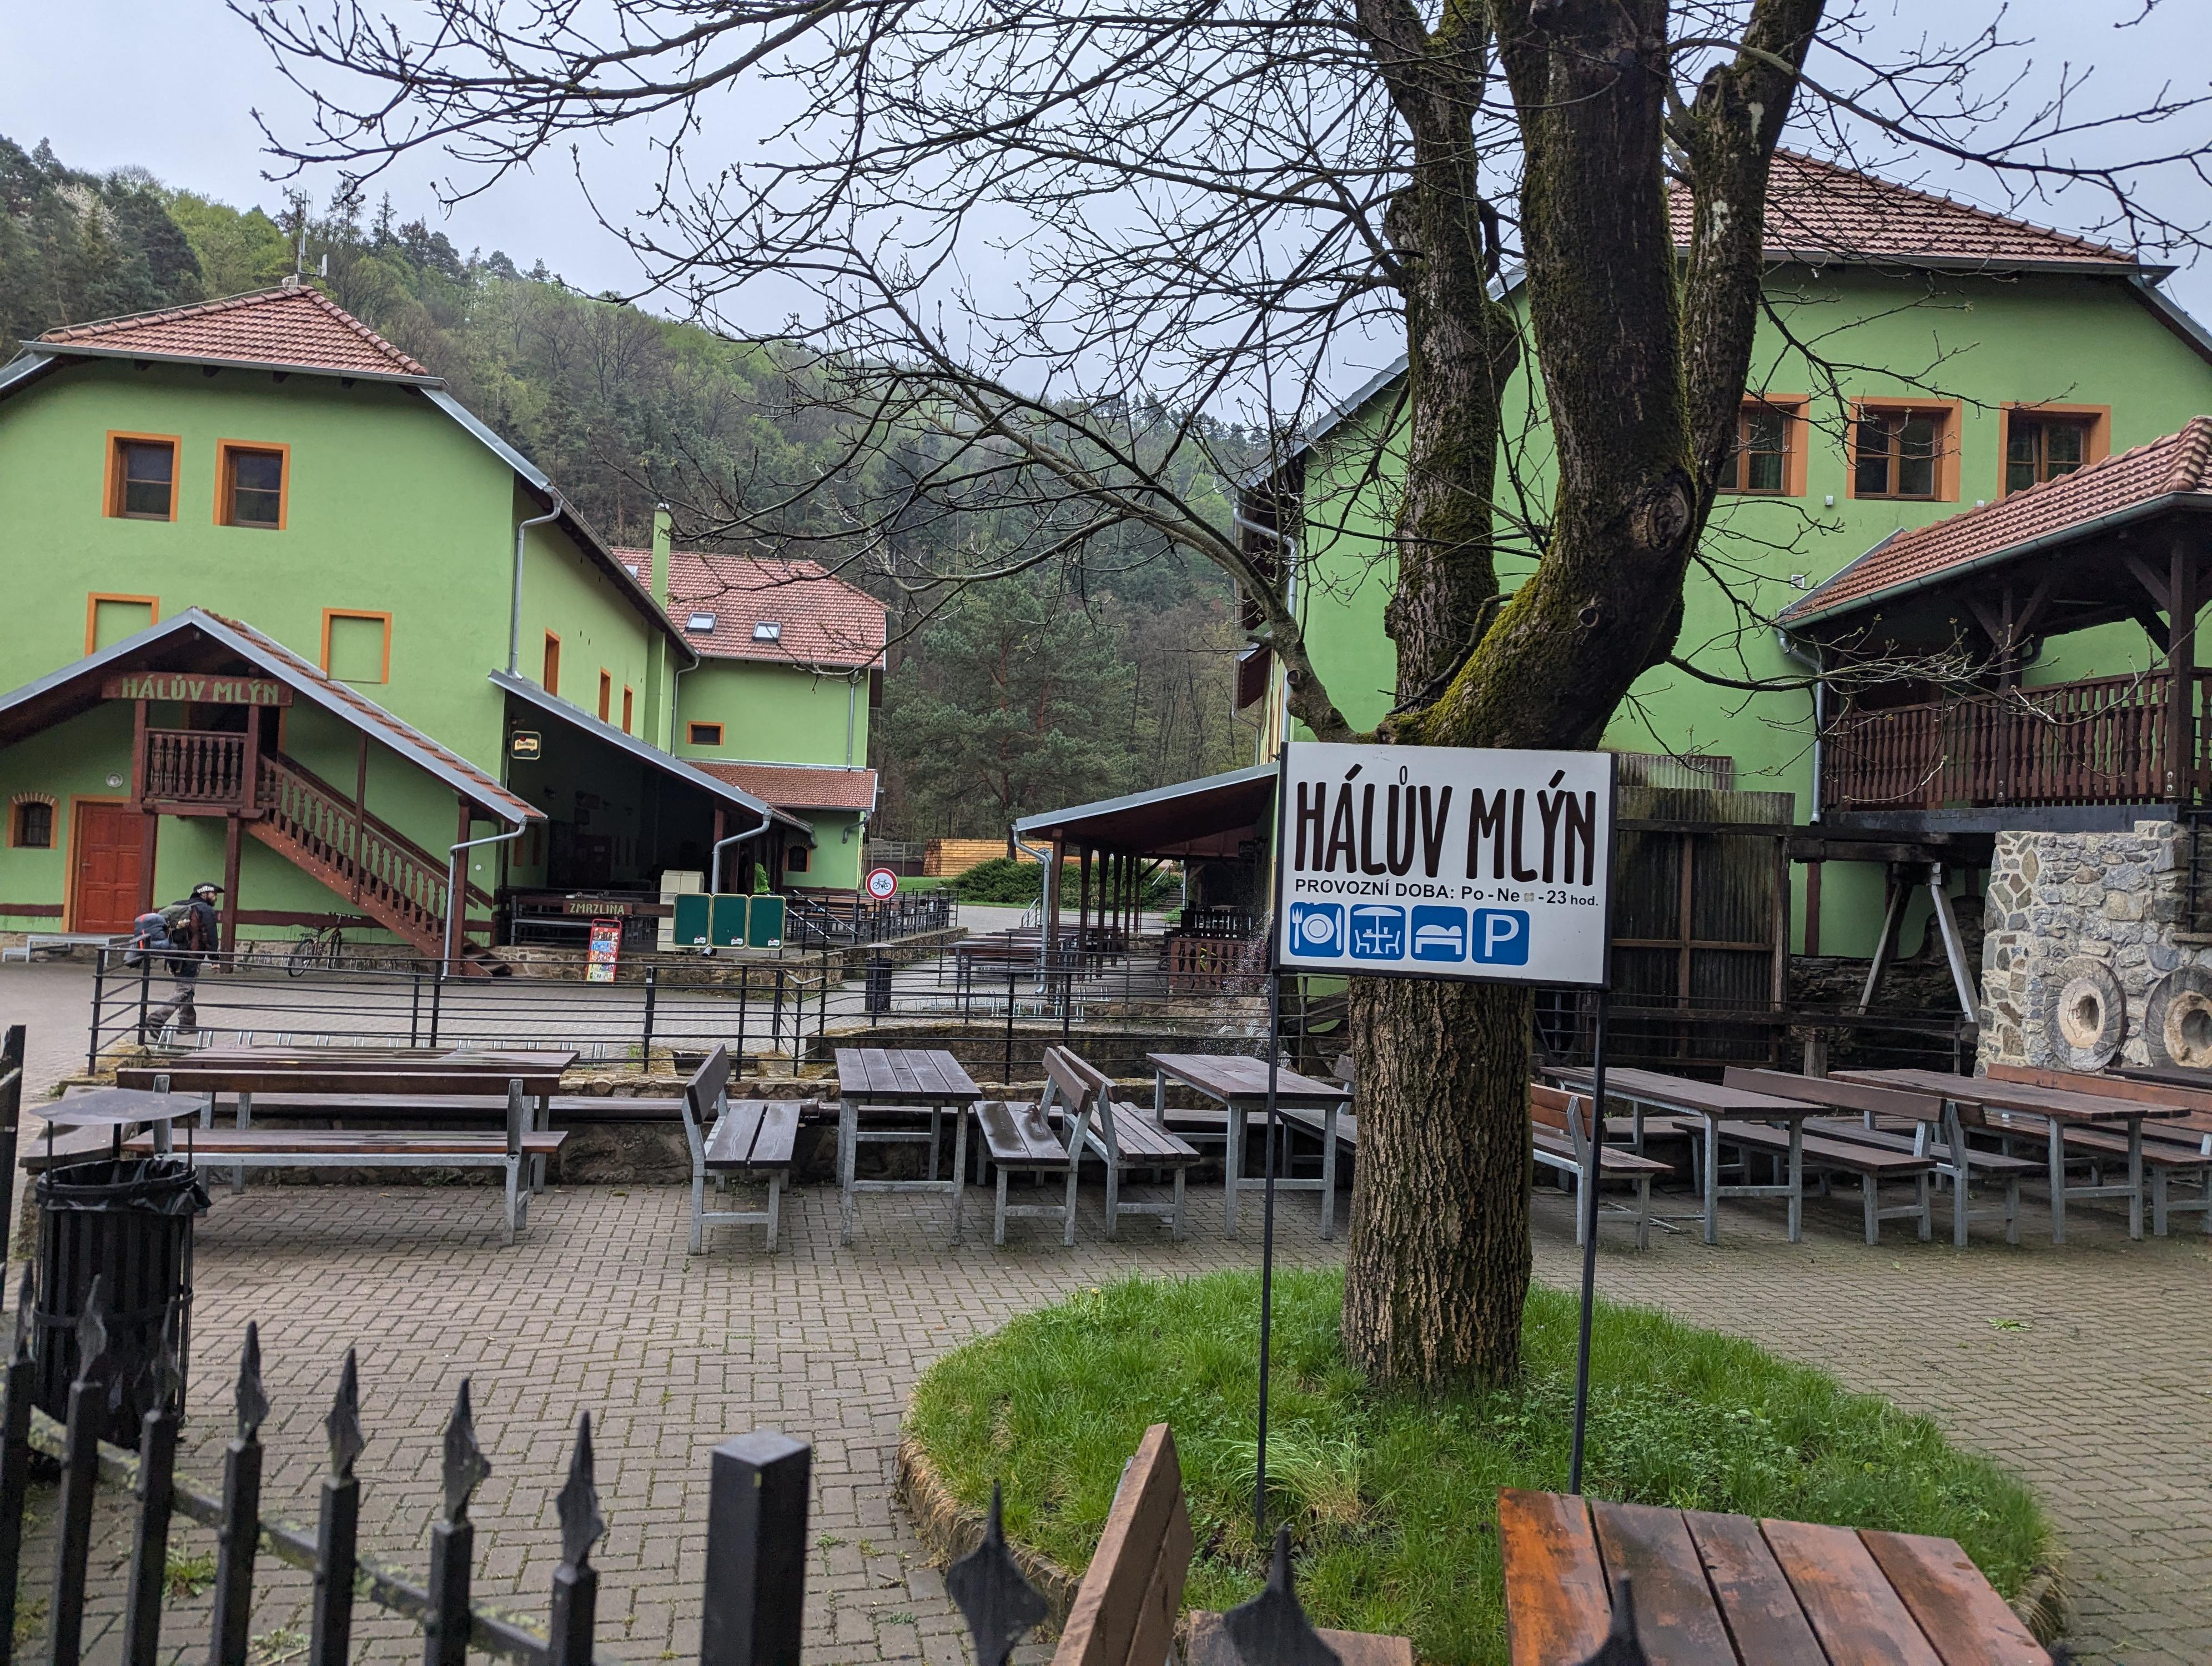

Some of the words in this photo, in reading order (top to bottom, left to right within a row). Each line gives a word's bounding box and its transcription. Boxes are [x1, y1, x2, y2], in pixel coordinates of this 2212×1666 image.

[122, 674, 205, 700] HÁLŮV
[213, 679, 278, 704] MLÝN
[1294, 763, 1453, 878] HÁLŮV
[1466, 769, 1596, 887] MLÝN
[1295, 879, 1390, 896] PROVOZNÍ
[1395, 882, 1454, 899] DOBA:
[1571, 895, 1598, 906] hod.
[570, 903, 625, 915] ZMRZLINA
[1485, 914, 1519, 957] P
